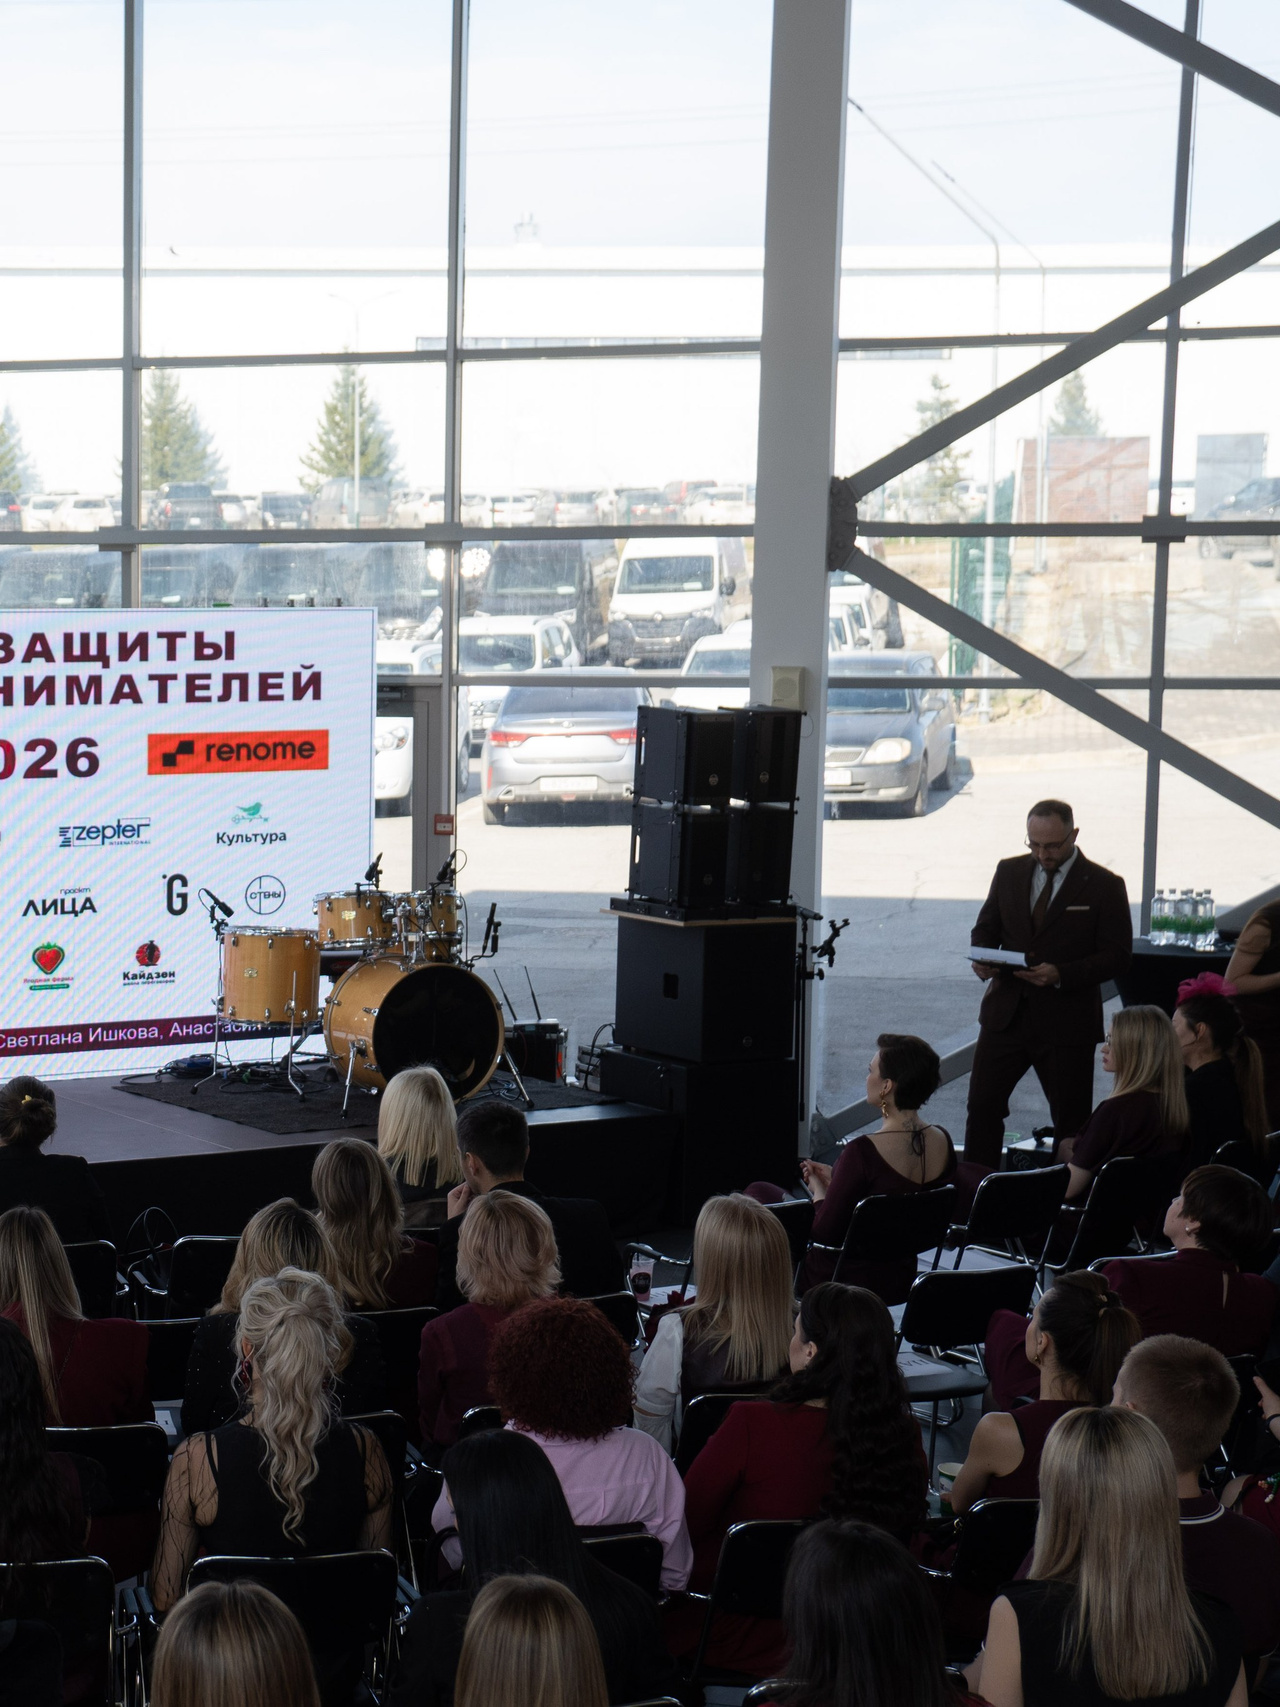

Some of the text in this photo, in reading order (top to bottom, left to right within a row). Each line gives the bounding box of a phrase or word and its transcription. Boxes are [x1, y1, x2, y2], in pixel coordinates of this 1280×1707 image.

[206, 740, 316, 762] renome
[73, 818, 150, 845] zepter
[216, 831, 287, 846] Культура
[22, 897, 97, 917] ЛИЦА
[89, 1026, 163, 1042] Ишкова,
[169, 1021, 262, 1038] Анасасия
